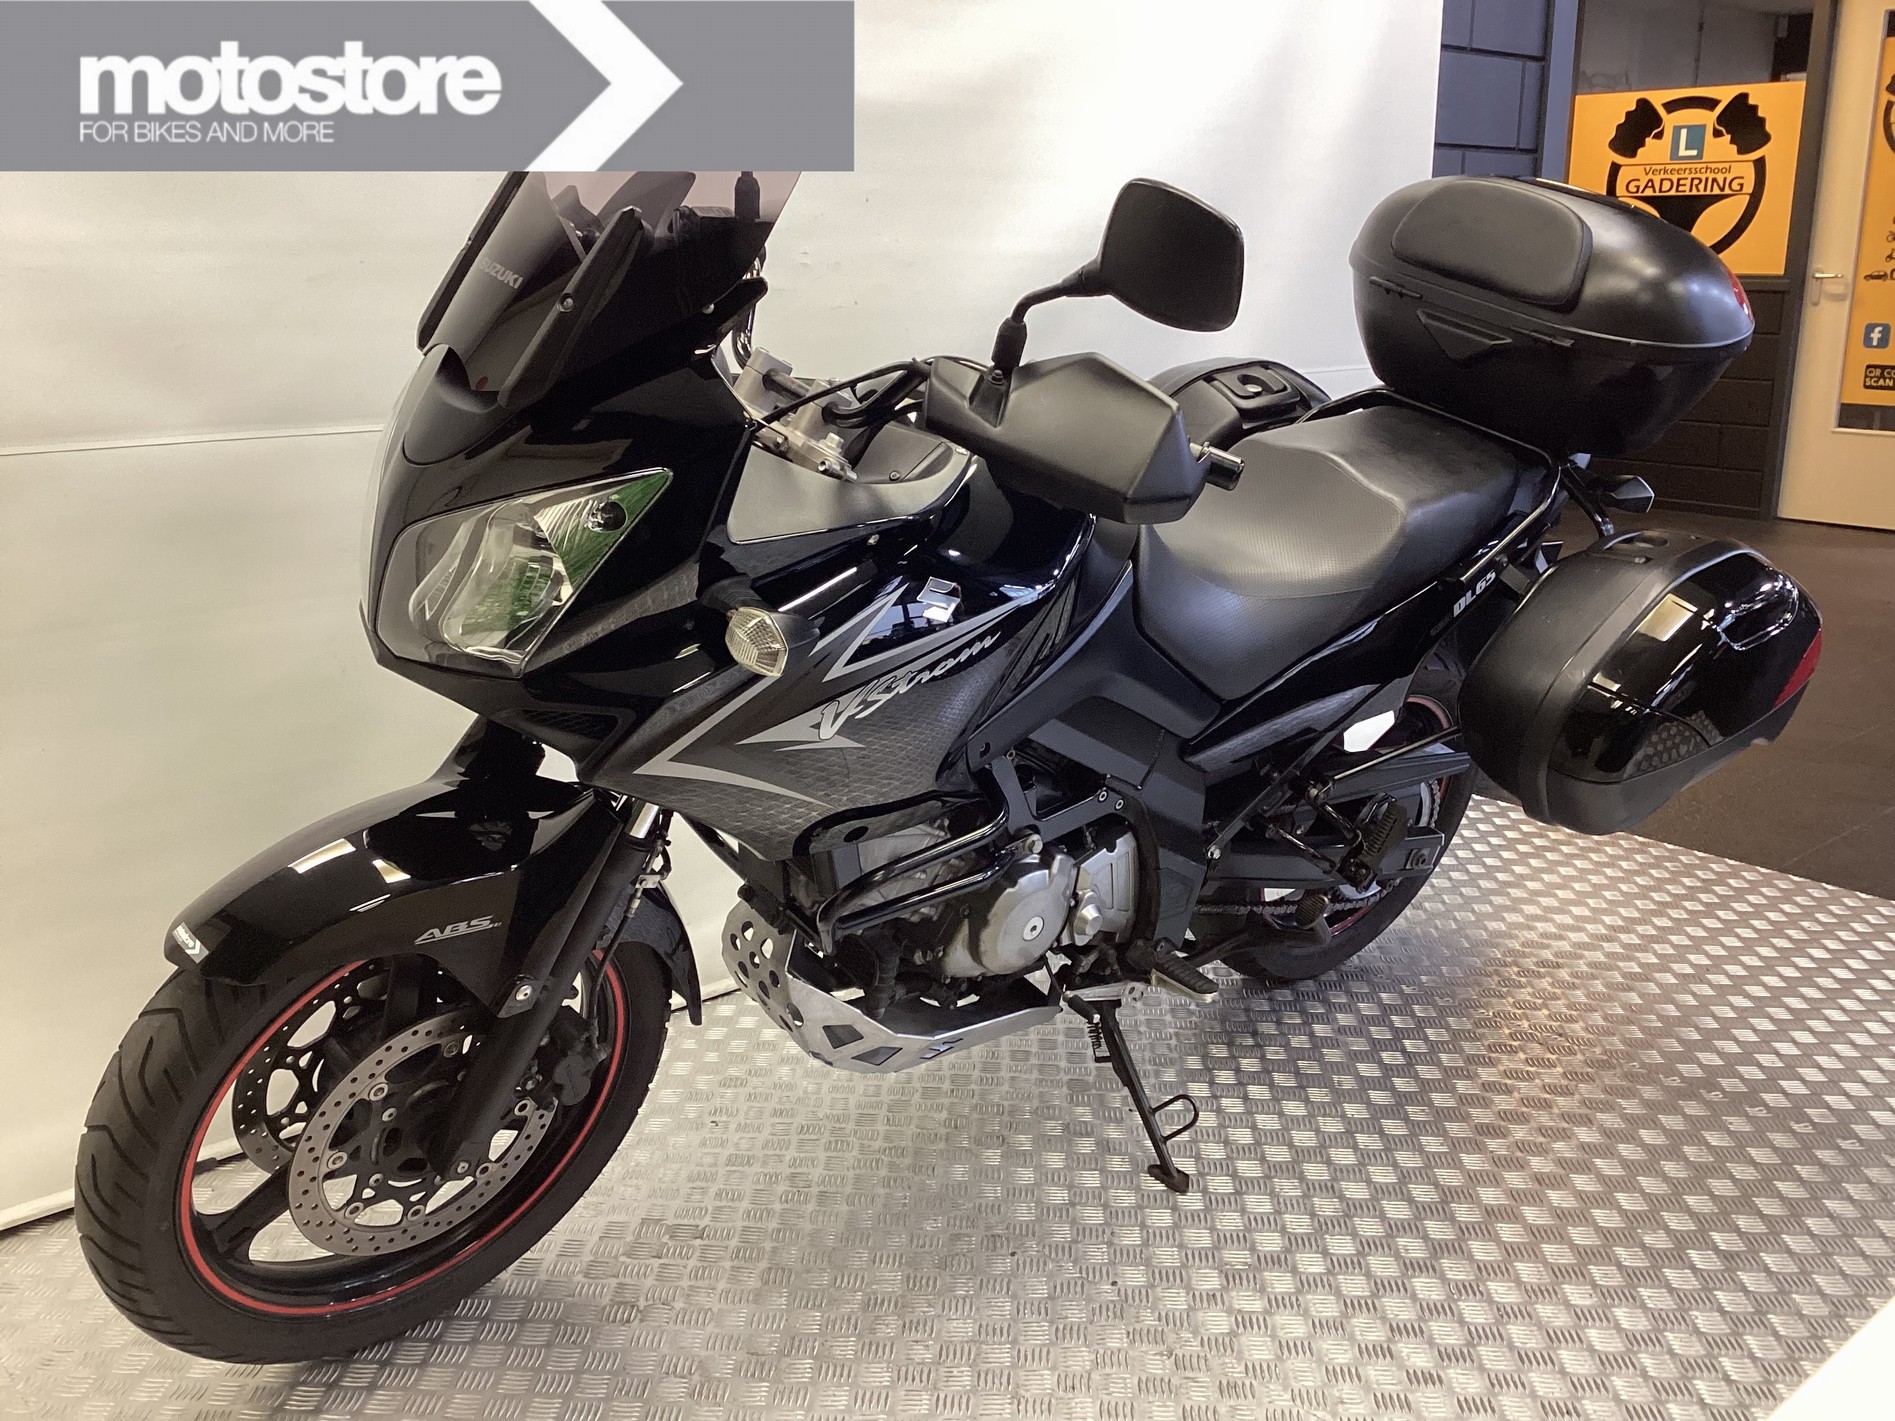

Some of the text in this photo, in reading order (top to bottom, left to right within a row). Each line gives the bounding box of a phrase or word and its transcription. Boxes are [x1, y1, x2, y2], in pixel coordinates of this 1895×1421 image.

[1643, 164, 1732, 176] Verkeersschool
[1625, 176, 1745, 195] GADERING
[481, 256, 524, 290] SUZUKI
[1866, 367, 1881, 377] QR
[1865, 377, 1894, 387] SCAN
[414, 915, 496, 943] ABS
